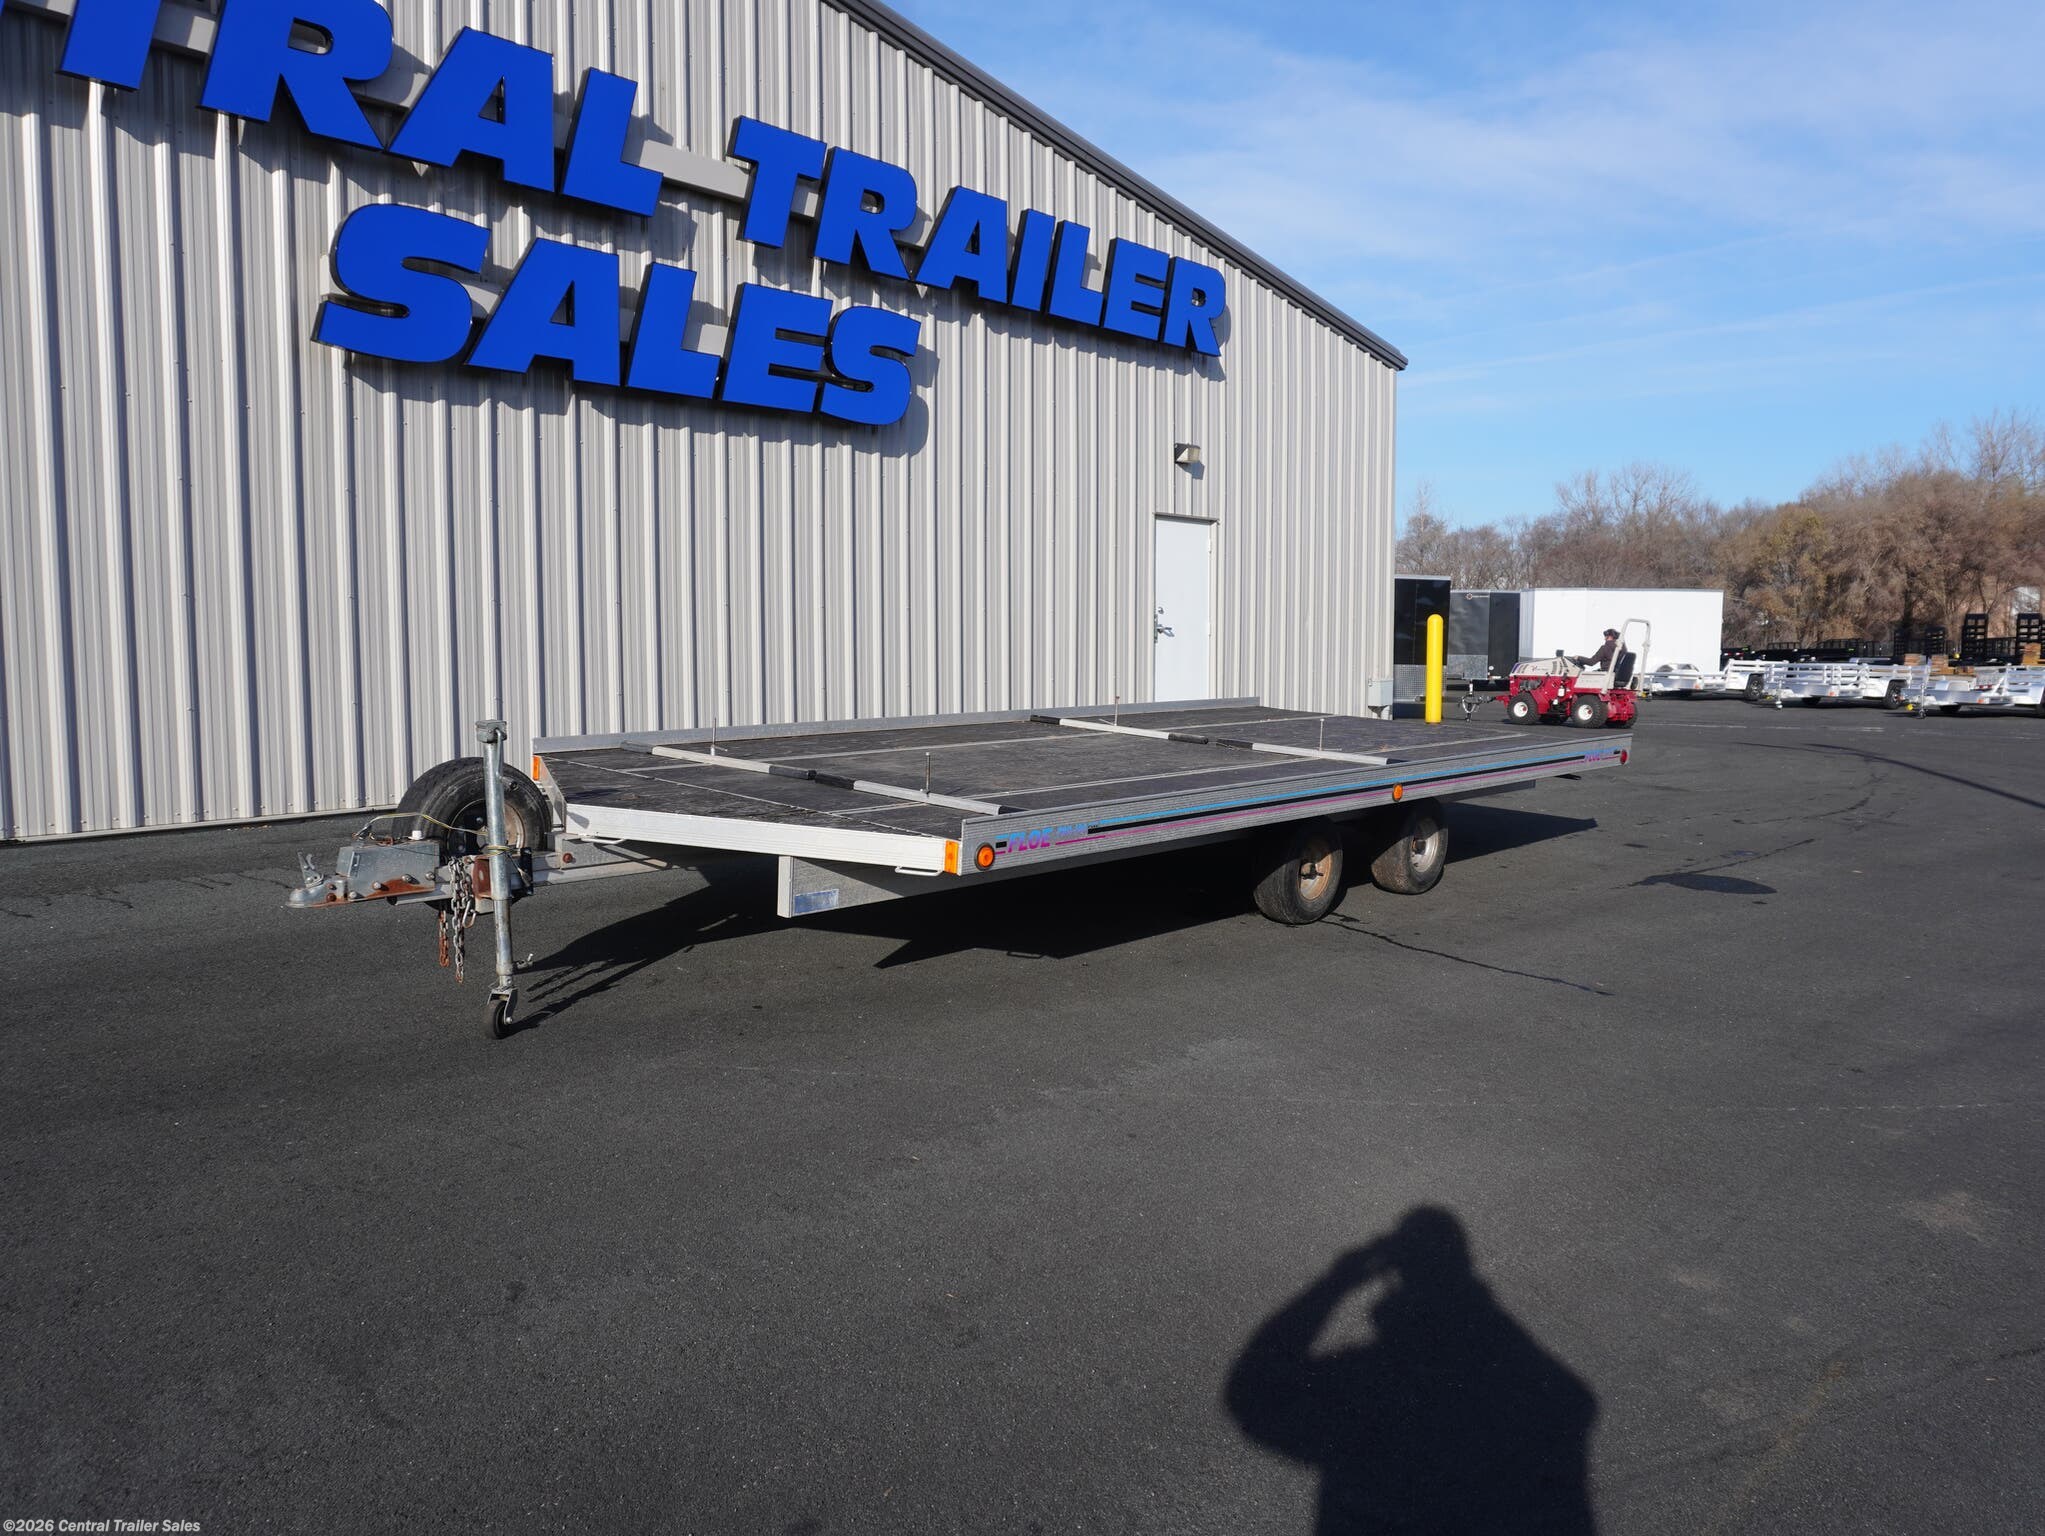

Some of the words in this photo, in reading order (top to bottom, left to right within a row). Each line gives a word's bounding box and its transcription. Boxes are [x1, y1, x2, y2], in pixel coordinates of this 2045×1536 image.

[311, 203, 921, 426] SALES
[730, 115, 1226, 357] TRAILER
[1008, 826, 1053, 853] FLOE
